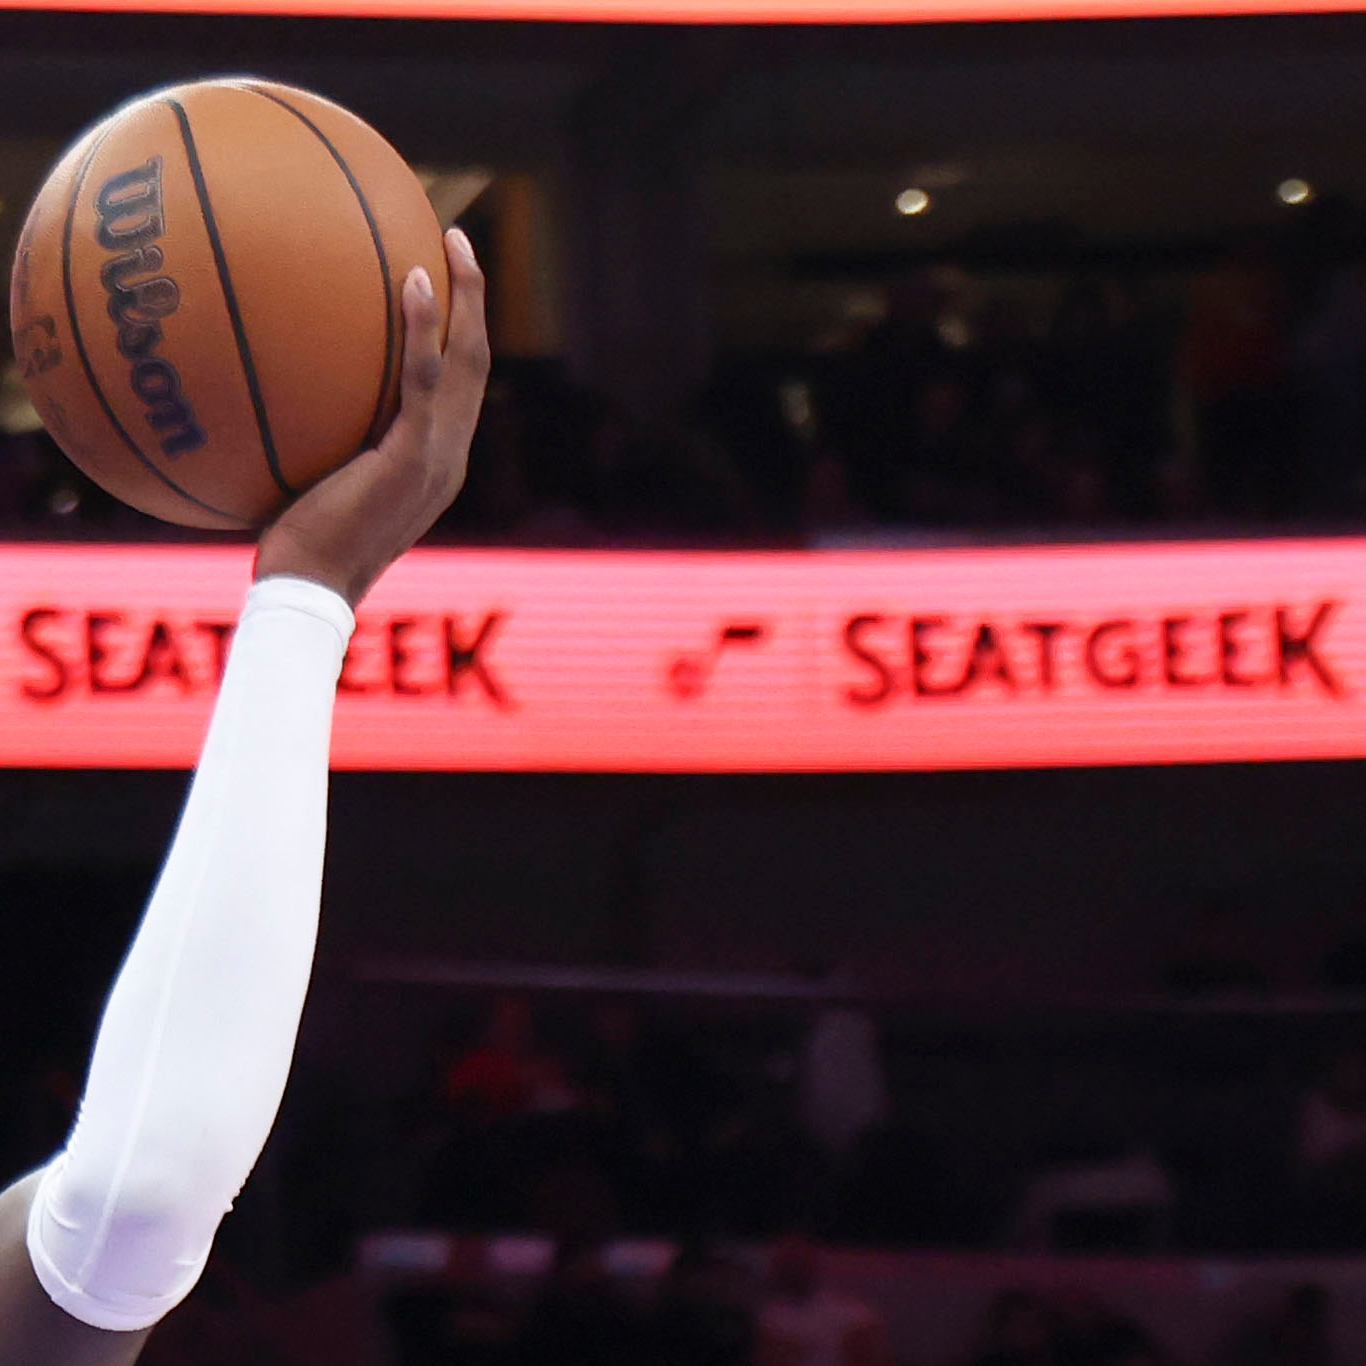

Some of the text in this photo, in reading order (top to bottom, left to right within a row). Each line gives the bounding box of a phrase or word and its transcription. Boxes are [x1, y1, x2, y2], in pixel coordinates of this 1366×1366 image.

[95, 156, 207, 454] Wilson
[20, 607, 515, 704] SEATEEK
[844, 598, 1346, 704] SEATGEEK
